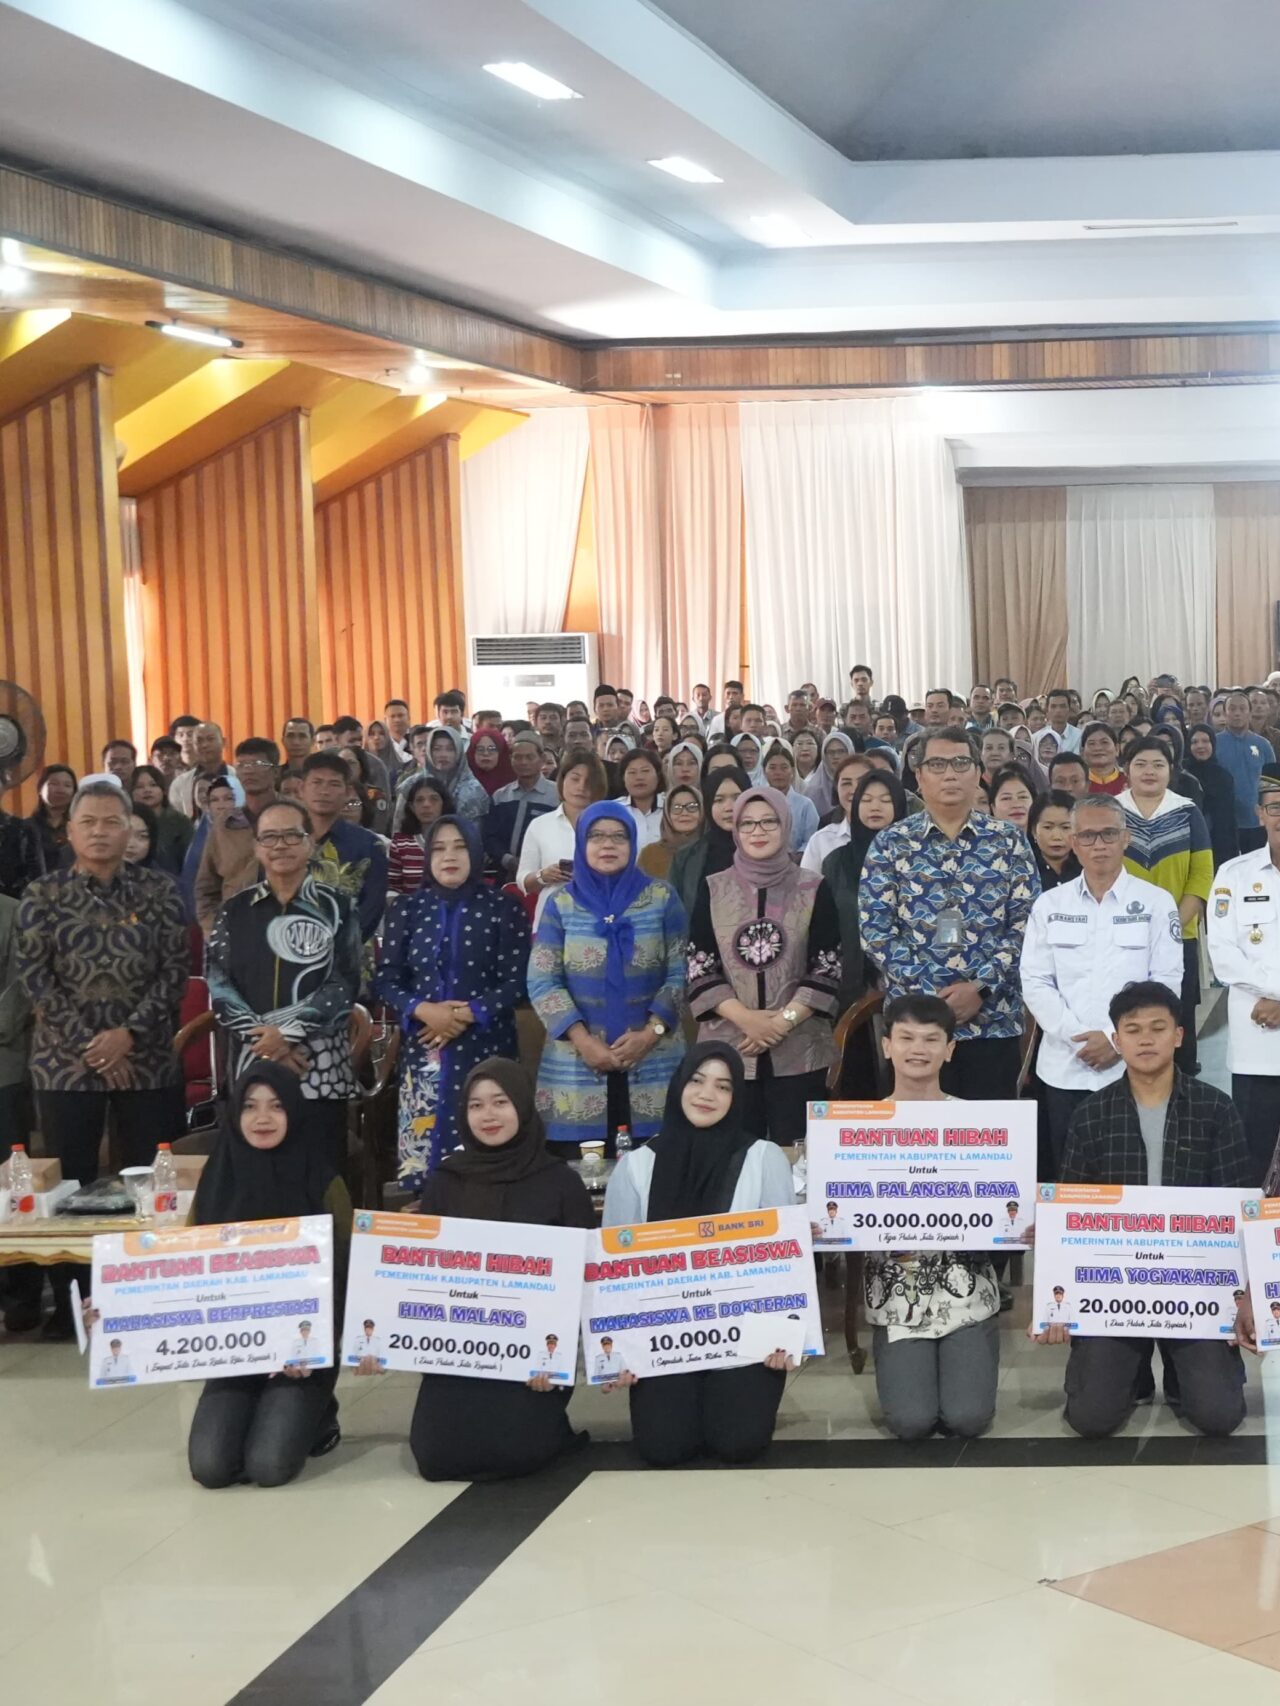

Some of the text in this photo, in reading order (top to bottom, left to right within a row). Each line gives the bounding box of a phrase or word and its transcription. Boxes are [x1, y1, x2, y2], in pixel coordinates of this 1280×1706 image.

[839, 1128, 1007, 1145] BANTUAN HIBAH
[826, 1182, 1019, 1198] HIMA PALANGKA RAYA
[718, 1219, 763, 1231] BANK BRI
[852, 1213, 992, 1230] 30.000.000,00
[1066, 1212, 1235, 1233] BANTUAN HIBAH
[1061, 1237, 1239, 1248] PEMERINTAH KABUPATEN LAMANDAU
[101, 1245, 320, 1283] BANTUAN BEASISWA
[380, 1243, 552, 1277] BANTUAN HIBAH
[583, 1238, 802, 1282] BANTUAN BEASISWA
[1135, 1252, 1164, 1260] Untuk
[374, 1269, 555, 1292] PEMERINTAH KABUPATEN LAMANDAU
[599, 1263, 790, 1294] PEMERINTAH DAERAH KAB. LAMANDAU
[1075, 1266, 1239, 1286] HIMA YOGYAKARTA
[196, 1292, 226, 1303] Untuk
[449, 1289, 478, 1299] Untuk
[681, 1287, 712, 1299] Untuk
[103, 1298, 318, 1333] MAHASISWA BERPRESTASI
[398, 1301, 526, 1328] HIMA MALANG
[589, 1292, 807, 1333] MAHASISWA KE DOKTERAN
[1079, 1298, 1219, 1318] 20.000.000,00
[155, 1330, 265, 1356] 4.200.000
[388, 1333, 531, 1361] 20.000.000,00
[648, 1325, 741, 1352] 10.000.0
